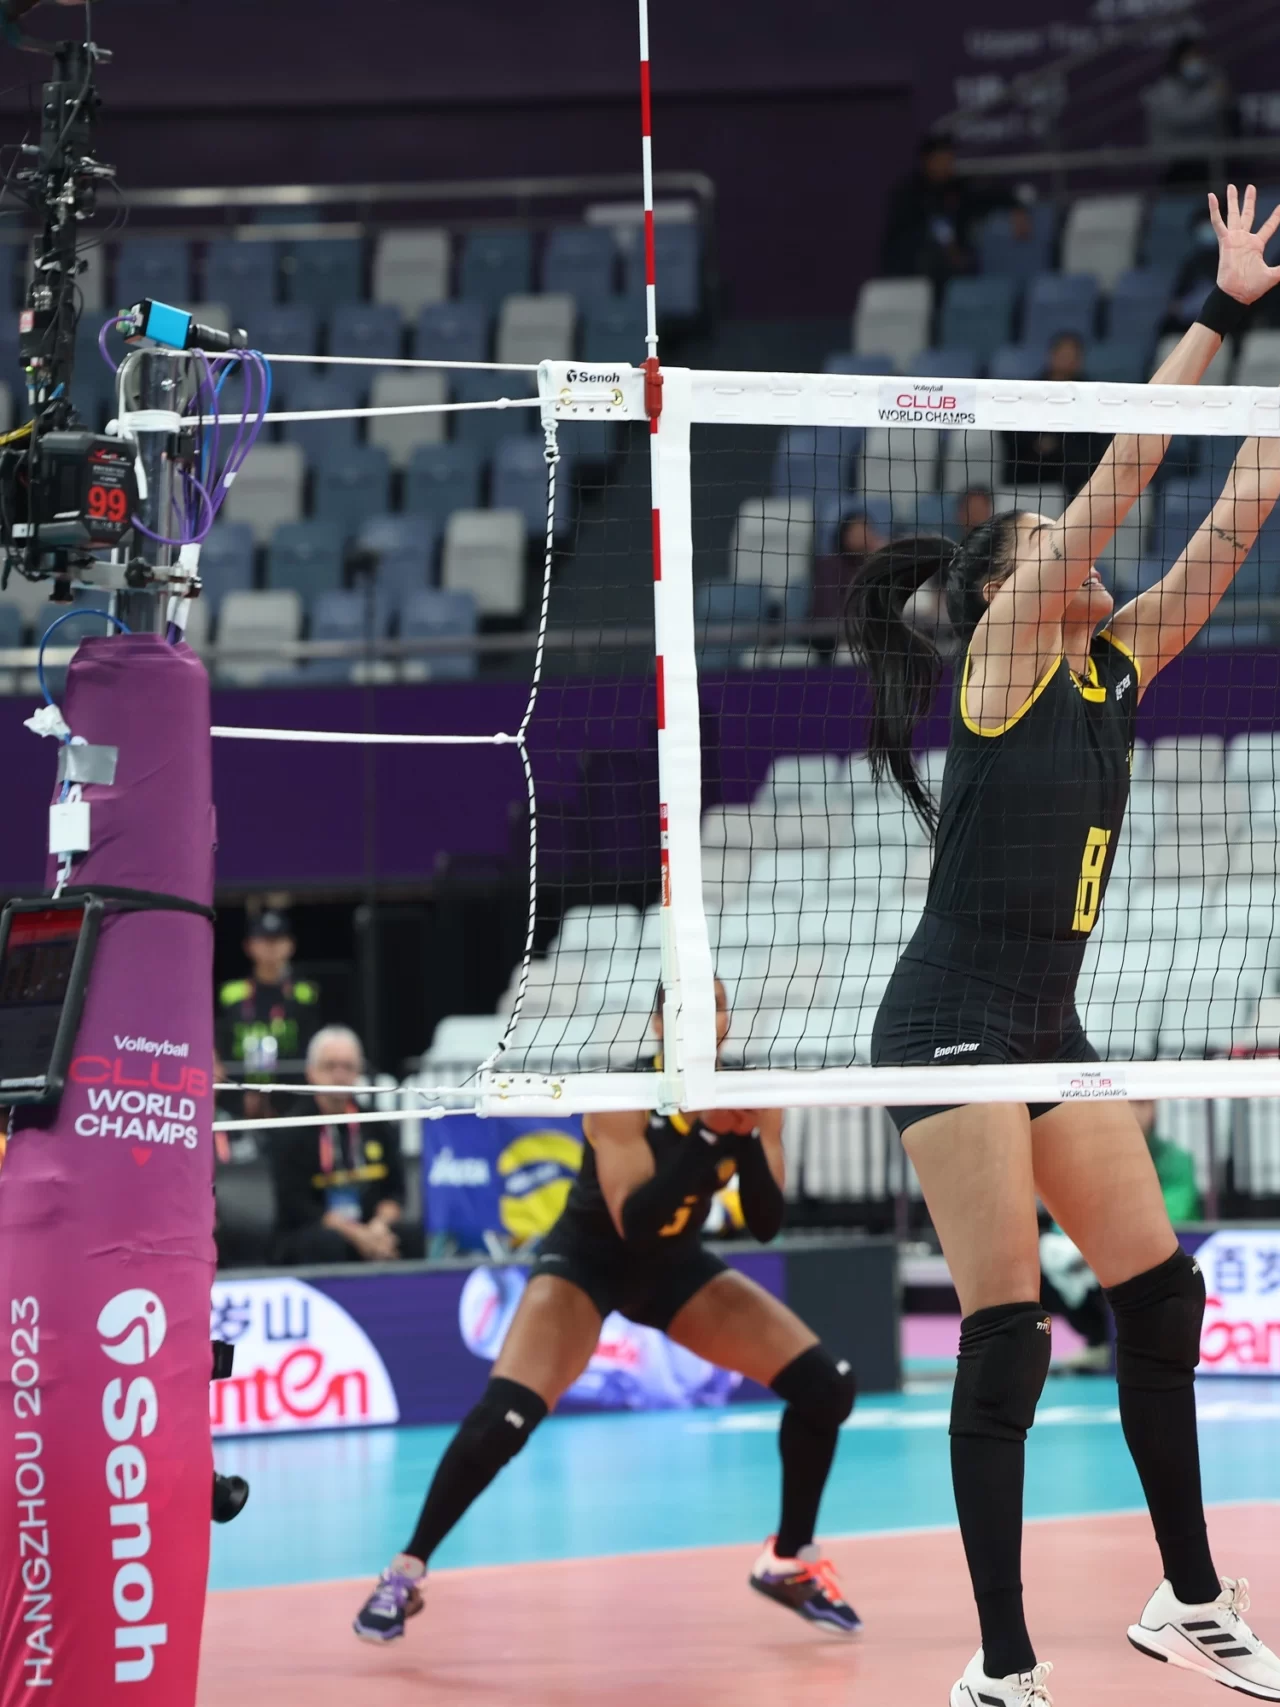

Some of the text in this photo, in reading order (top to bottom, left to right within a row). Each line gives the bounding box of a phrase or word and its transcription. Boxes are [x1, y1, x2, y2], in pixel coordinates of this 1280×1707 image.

[579, 372, 620, 383] Senoh
[878, 409, 976, 424] WORLD CHAMPS
[896, 394, 957, 409] CLUB
[87, 485, 128, 522] 99
[1071, 826, 1111, 933] 8
[113, 1034, 190, 1058] Volleyball
[69, 1055, 208, 1097] CLUB
[87, 1088, 196, 1121] WORLD
[74, 1113, 199, 1149] CHAMPS
[211, 1295, 310, 1344] 岁山
[11, 1296, 54, 1687] HANGZHOU 2023
[102, 1376, 168, 1683] Senoh
